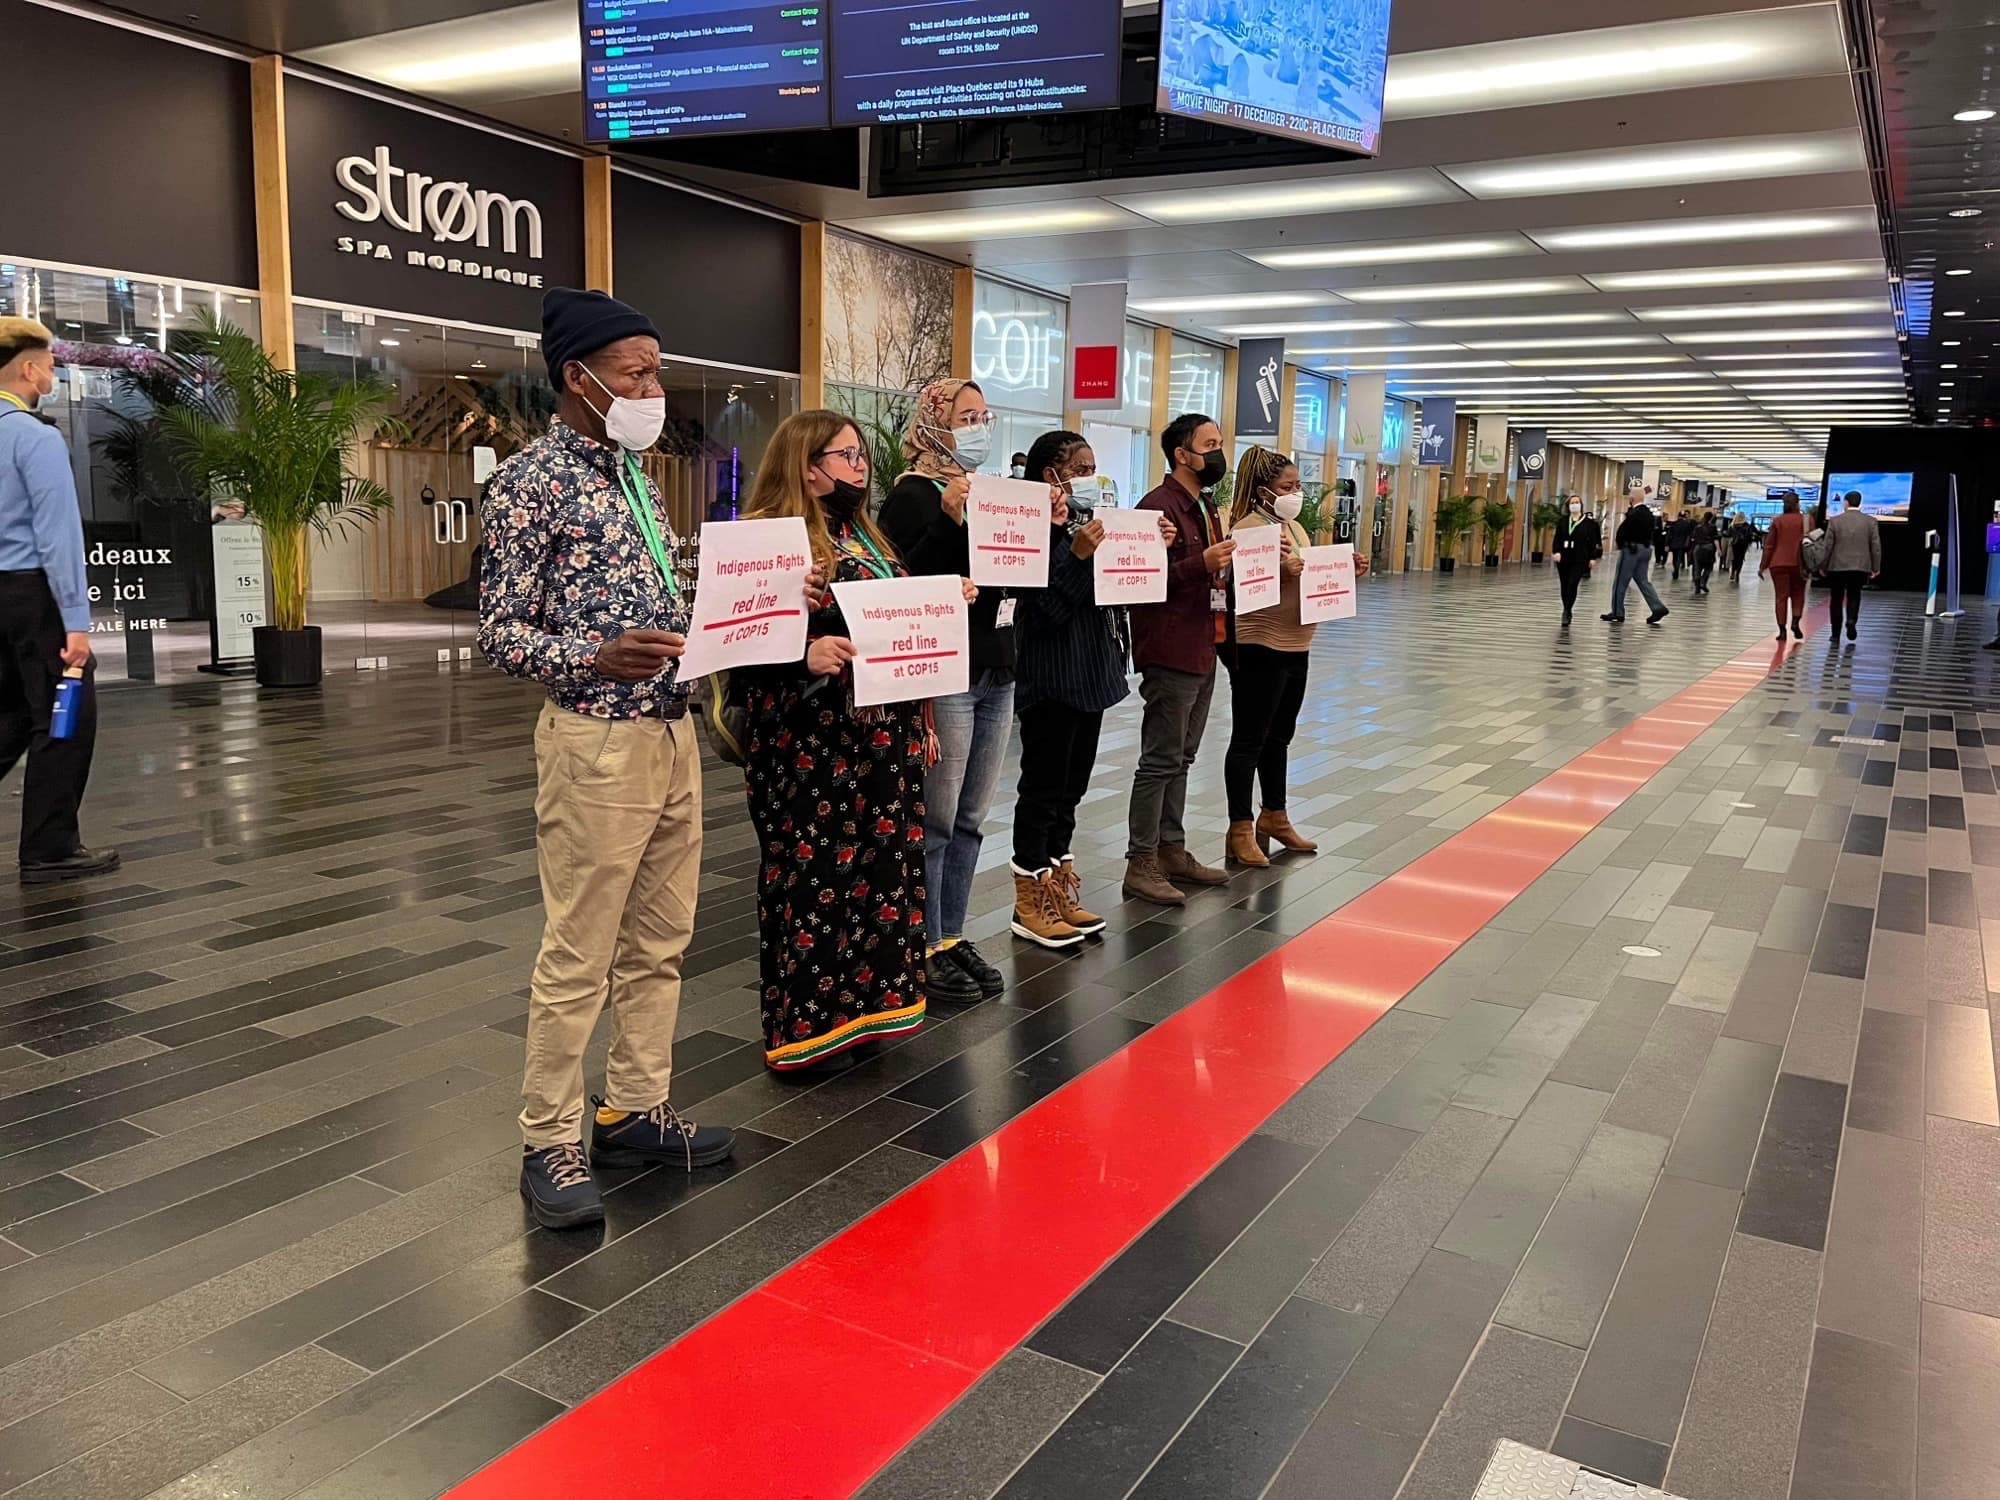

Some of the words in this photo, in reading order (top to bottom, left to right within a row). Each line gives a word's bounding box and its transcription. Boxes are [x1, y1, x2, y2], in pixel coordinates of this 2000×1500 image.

[802, 8, 818, 16] Group
[934, 20, 944, 28] and
[946, 18, 963, 26] found
[964, 16, 980, 25] office
[988, 13, 1010, 22] located
[1012, 12, 1018, 20] at
[1019, 11, 1030, 19] the
[618, 36, 636, 44] Contact
[659, 32, 670, 40] COP
[670, 30, 689, 40] Agenda
[912, 34, 945, 44] Department
[946, 32, 952, 40] of
[954, 32, 972, 41] Safety
[974, 30, 984, 38] and
[986, 28, 1010, 38] Security
[782, 49, 802, 57] Contact
[938, 48, 955, 56] room
[985, 42, 1000, 51] floor
[638, 72, 652, 80] Group
[672, 68, 690, 77] Agenda
[716, 64, 738, 72] Financial
[739, 62, 769, 70] mechanism
[778, 88, 800, 96] Working
[800, 86, 816, 94] Group
[896, 89, 916, 98] Come
[917, 86, 930, 96] and
[930, 86, 944, 94] visit
[946, 84, 965, 94] Place
[966, 82, 992, 92] Quebec
[994, 80, 1007, 90] and
[1025, 78, 1044, 86] Hubs
[857, 101, 872, 110] with
[878, 100, 894, 109] daily
[894, 98, 932, 108] programme
[934, 96, 942, 104] of
[942, 94, 972, 104] activities
[974, 91, 1004, 101] focusing
[1016, 89, 1031, 98] CBD
[1017, 102, 1038, 111] United
[1177, 91, 1204, 110] MOVIE
[1204, 97, 1229, 115] NIGHT
[1234, 104, 1243, 118] 17
[1245, 106, 1285, 127] DECEMBER
[1312, 121, 1336, 138] PLACE
[335, 145, 543, 258] strøm
[337, 237, 392, 260] SPA
[407, 251, 543, 288] NORDIQUE
[978, 500, 1018, 516] Indigenous
[1020, 505, 1040, 519] Rights
[993, 530, 1008, 544] red
[1010, 530, 1026, 544] line
[1104, 530, 1137, 542] ndigenous
[83, 542, 173, 566] deaux
[994, 556, 1000, 565] at
[1002, 554, 1026, 566] COP15
[1118, 554, 1130, 566] red
[1132, 554, 1146, 566] line
[716, 559, 774, 576] Indigenous
[776, 554, 806, 570] Rights
[113, 577, 146, 600] ici
[237, 577, 250, 587] 15
[756, 578, 762, 587] is
[1118, 576, 1124, 586] at
[1126, 576, 1147, 585] COP15
[732, 594, 755, 614] red
[756, 592, 778, 610] line
[240, 614, 252, 624] 10
[862, 607, 922, 621] Indigenous
[924, 604, 954, 618] Rights
[129, 618, 168, 630] HERE
[723, 631, 734, 645] at
[736, 622, 770, 641] COP15
[892, 635, 912, 652] red
[916, 634, 938, 650] line
[894, 666, 904, 678] at
[907, 662, 939, 676] COP15
